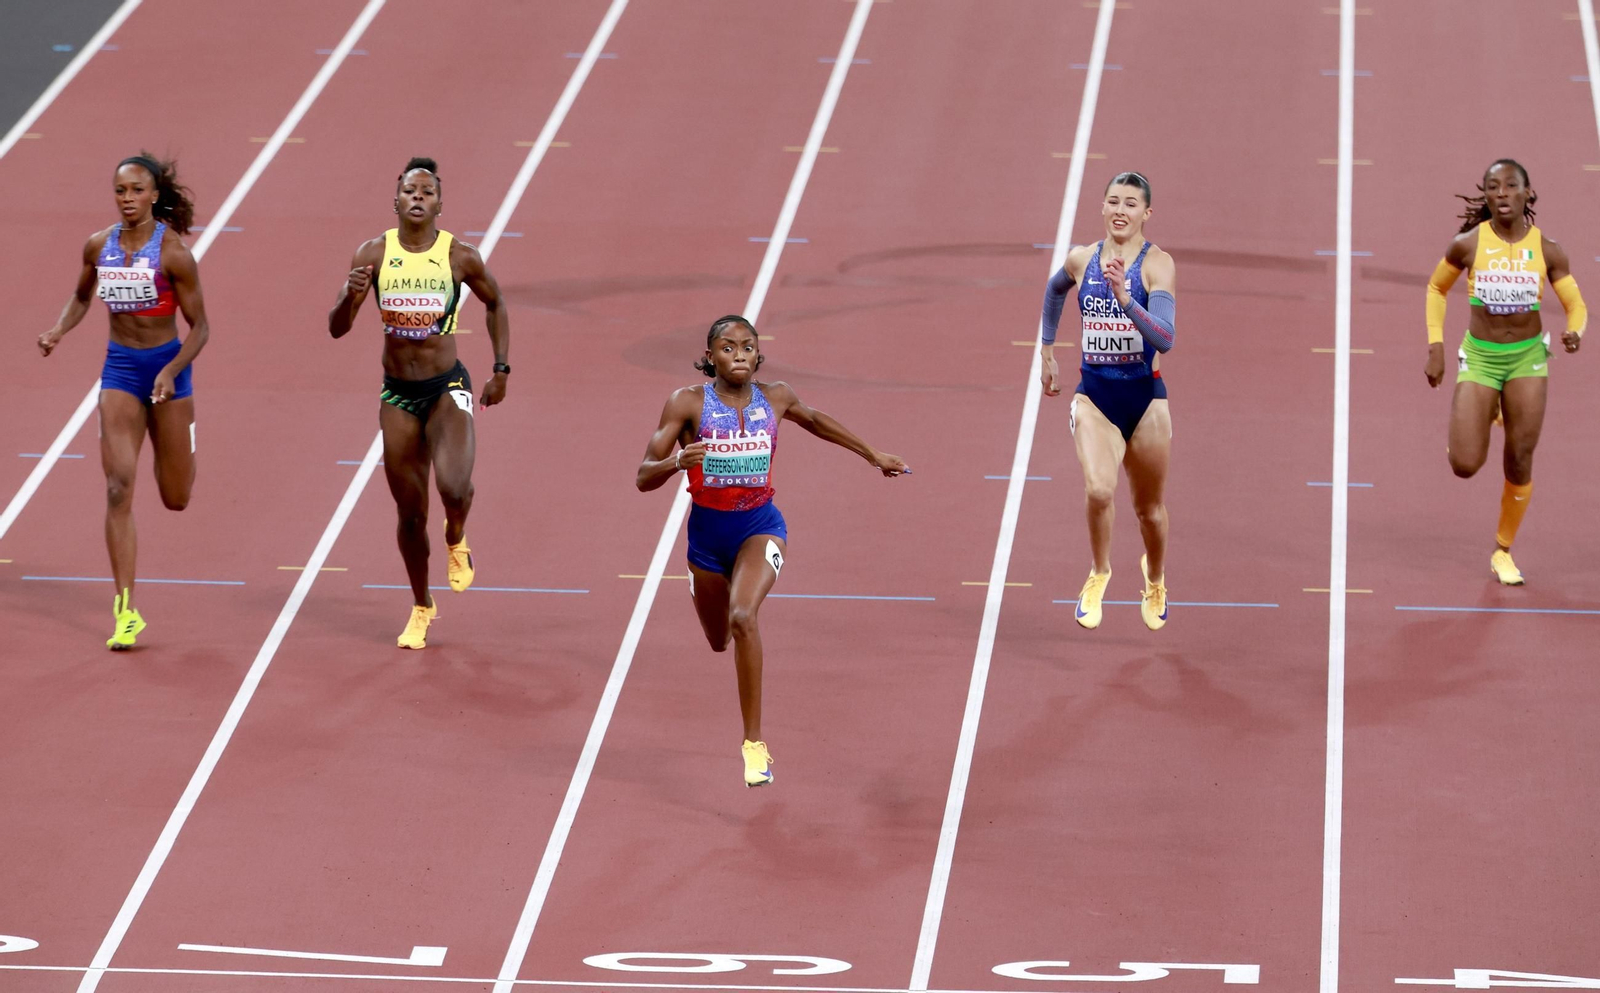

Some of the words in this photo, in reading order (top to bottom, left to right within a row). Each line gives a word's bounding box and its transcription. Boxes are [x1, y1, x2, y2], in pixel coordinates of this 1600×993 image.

[1488, 256, 1527, 272] CÔTE
[99, 272, 151, 281] HONDA
[1477, 275, 1537, 284] HONDA
[385, 278, 446, 291] JAMAICA
[101, 286, 153, 299] BATTLE
[382, 297, 443, 307] HONDA
[1083, 295, 1124, 312] GREA
[1084, 321, 1138, 332] HONDA
[1087, 337, 1134, 351] HUNT
[459, 393, 469, 407] 7
[703, 441, 769, 453] HONDA
[178, 944, 447, 967] 7
[992, 961, 1260, 984] 5
